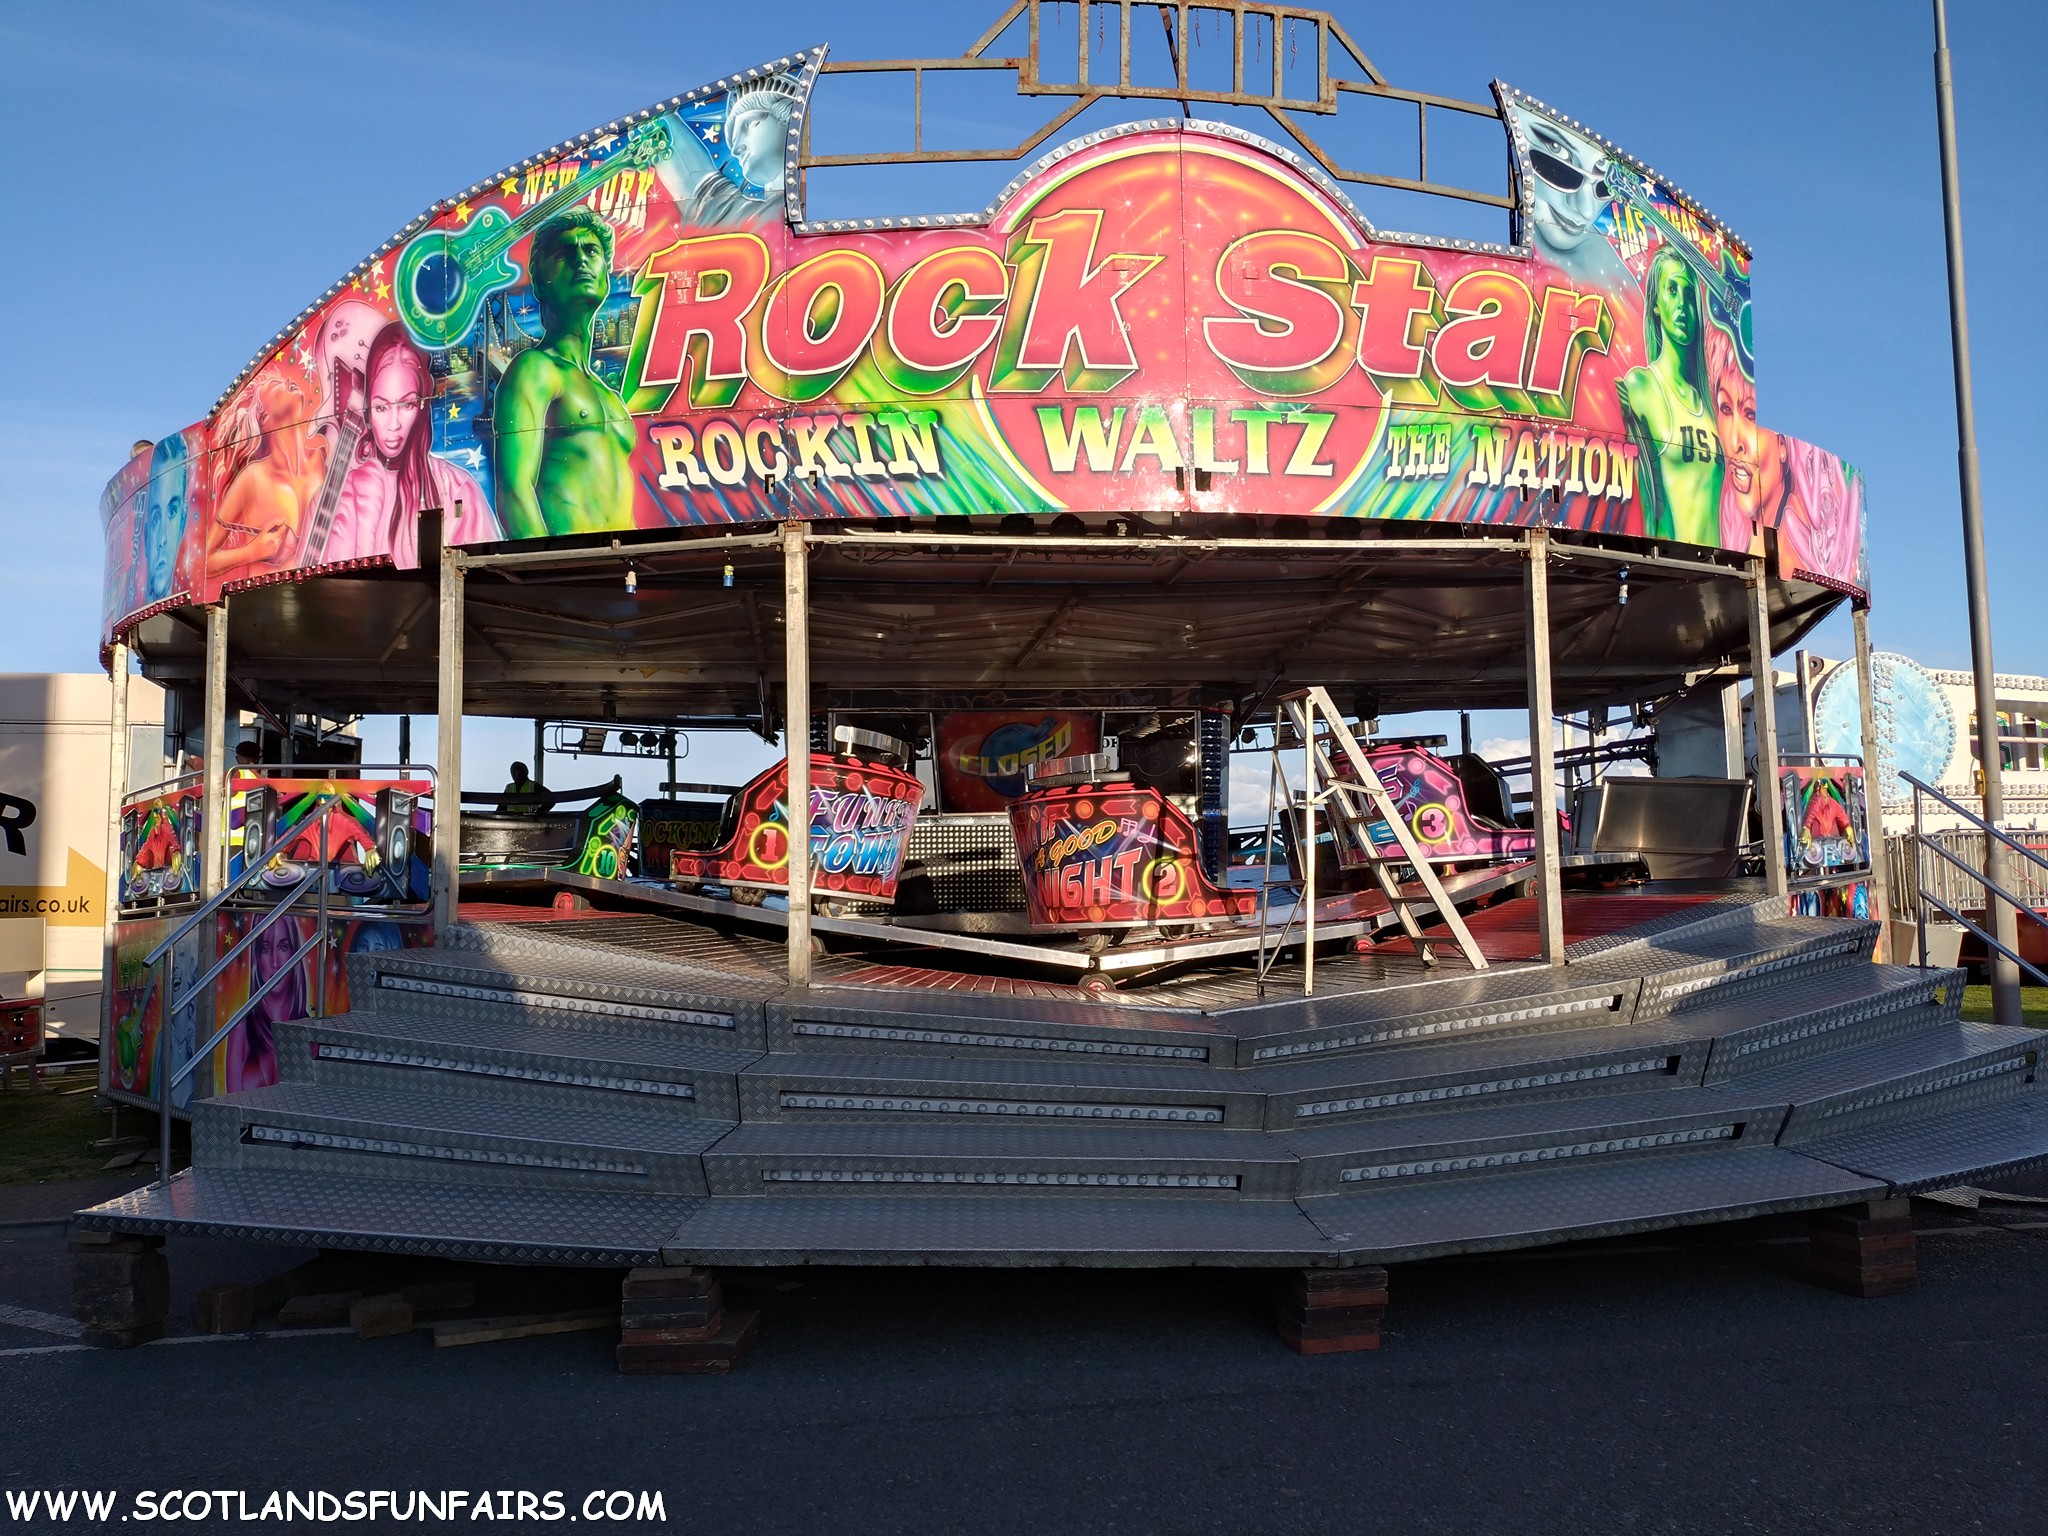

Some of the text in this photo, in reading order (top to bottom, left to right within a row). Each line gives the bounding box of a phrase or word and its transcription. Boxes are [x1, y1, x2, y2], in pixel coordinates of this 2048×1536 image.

[522, 161, 581, 205] NEW
[1611, 202, 1649, 261] LAS
[622, 207, 1616, 421] Rock Star
[649, 405, 1639, 502] ROCKIN WALTZ THE NATION
[960, 721, 1072, 778] CLOSED
[641, 819, 721, 851] OCKING
[760, 828, 779, 862] 1
[1421, 808, 1445, 838] 3
[599, 849, 616, 876] 10
[1037, 847, 1143, 907] NIGHT
[1156, 863, 1178, 897] 2
